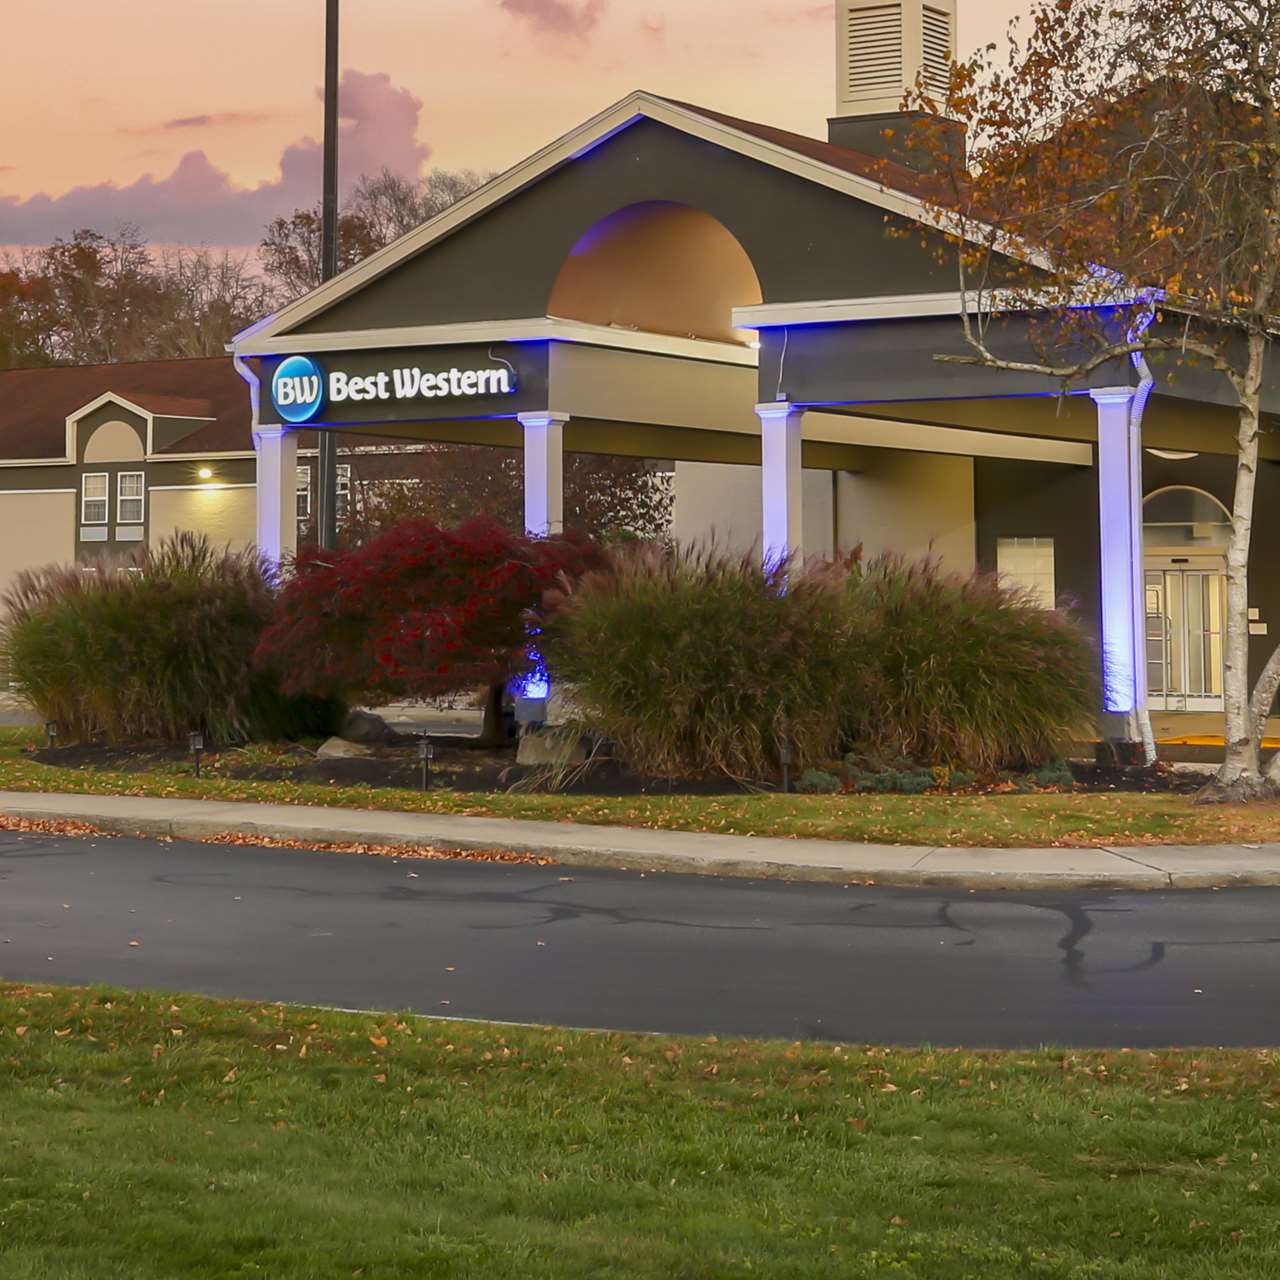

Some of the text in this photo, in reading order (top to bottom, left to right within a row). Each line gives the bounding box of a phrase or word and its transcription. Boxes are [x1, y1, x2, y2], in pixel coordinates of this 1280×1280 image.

[277, 375, 318, 405] BW
[329, 367, 509, 401] Best Western
